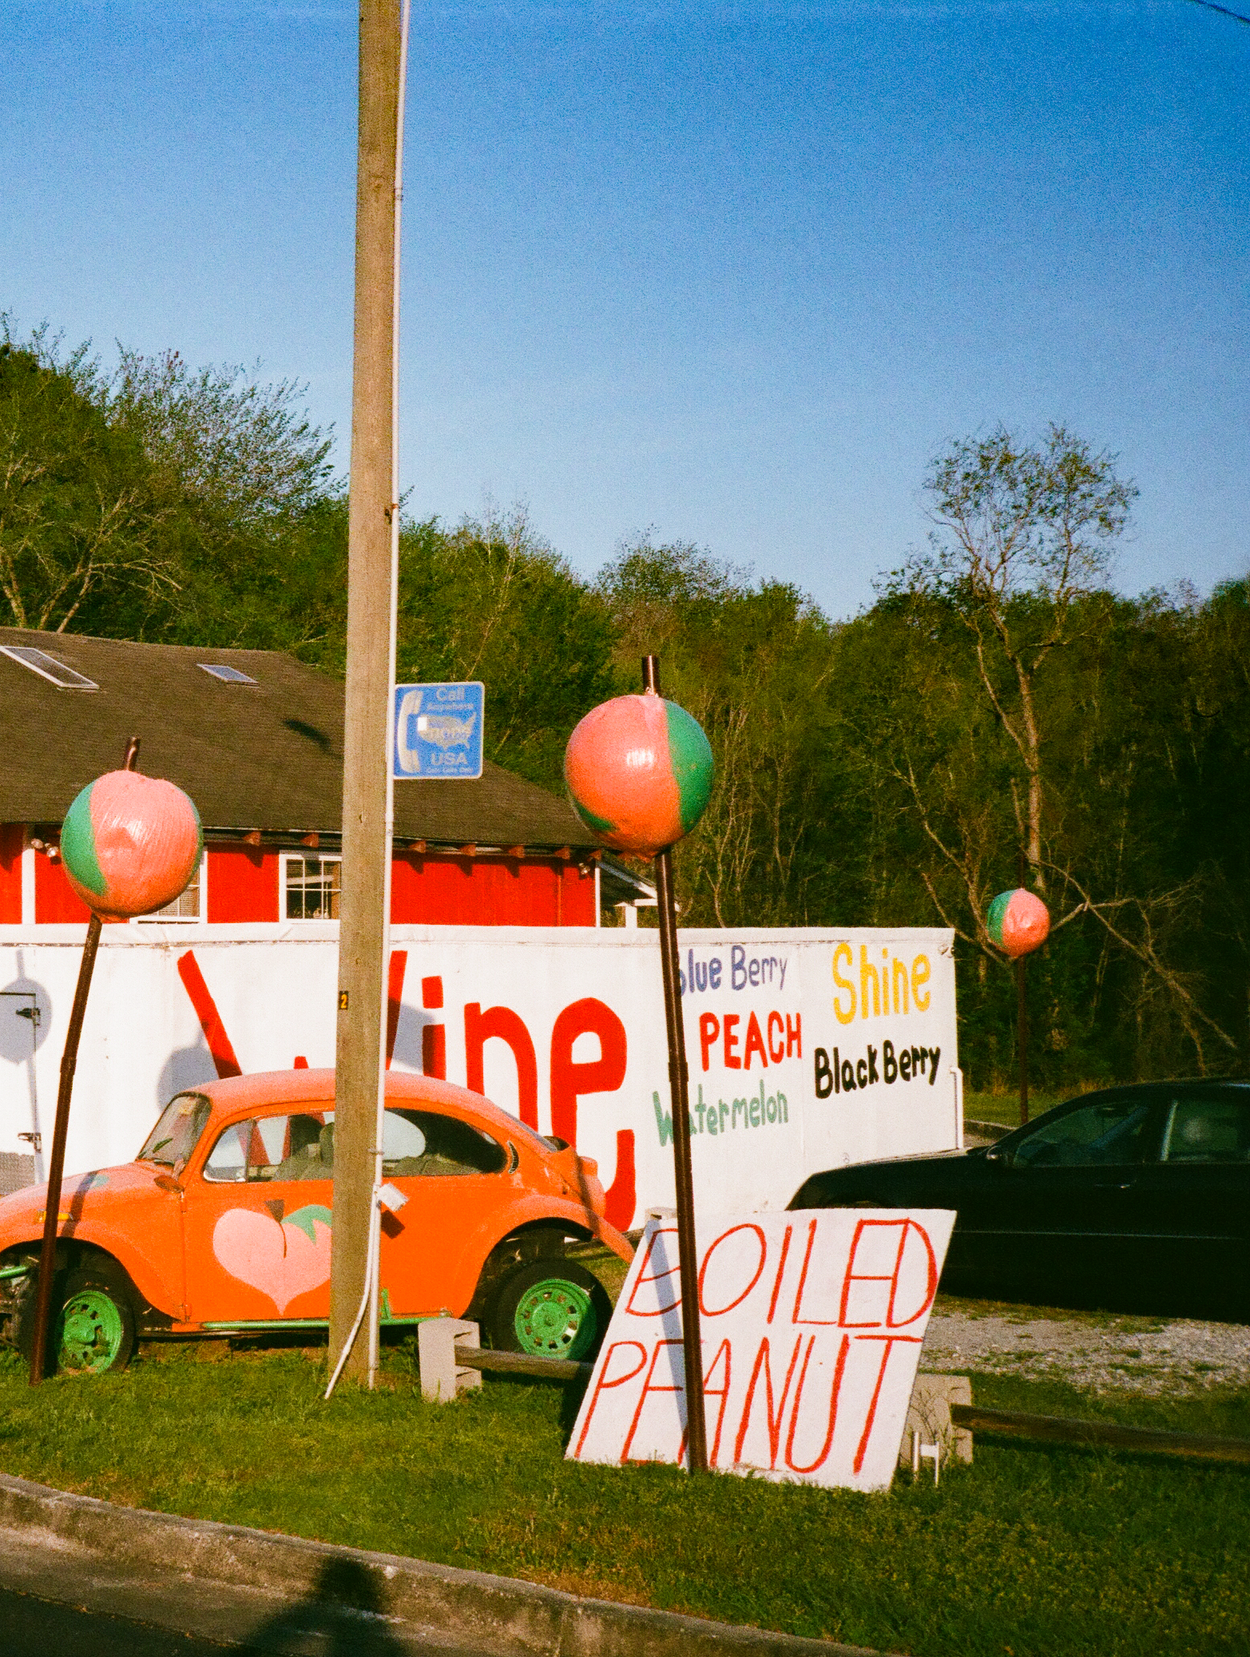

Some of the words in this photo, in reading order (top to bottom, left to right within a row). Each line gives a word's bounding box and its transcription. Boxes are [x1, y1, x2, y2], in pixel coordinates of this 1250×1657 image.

[436, 686, 465, 701] Call
[431, 752, 468, 765] USA
[731, 944, 788, 991] Berry
[831, 942, 931, 1025] Shine
[340, 993, 348, 1009] 2
[699, 1010, 802, 1072] PEACH
[625, 1217, 939, 1329] BOILED
[574, 1332, 924, 1476] PEANUT
